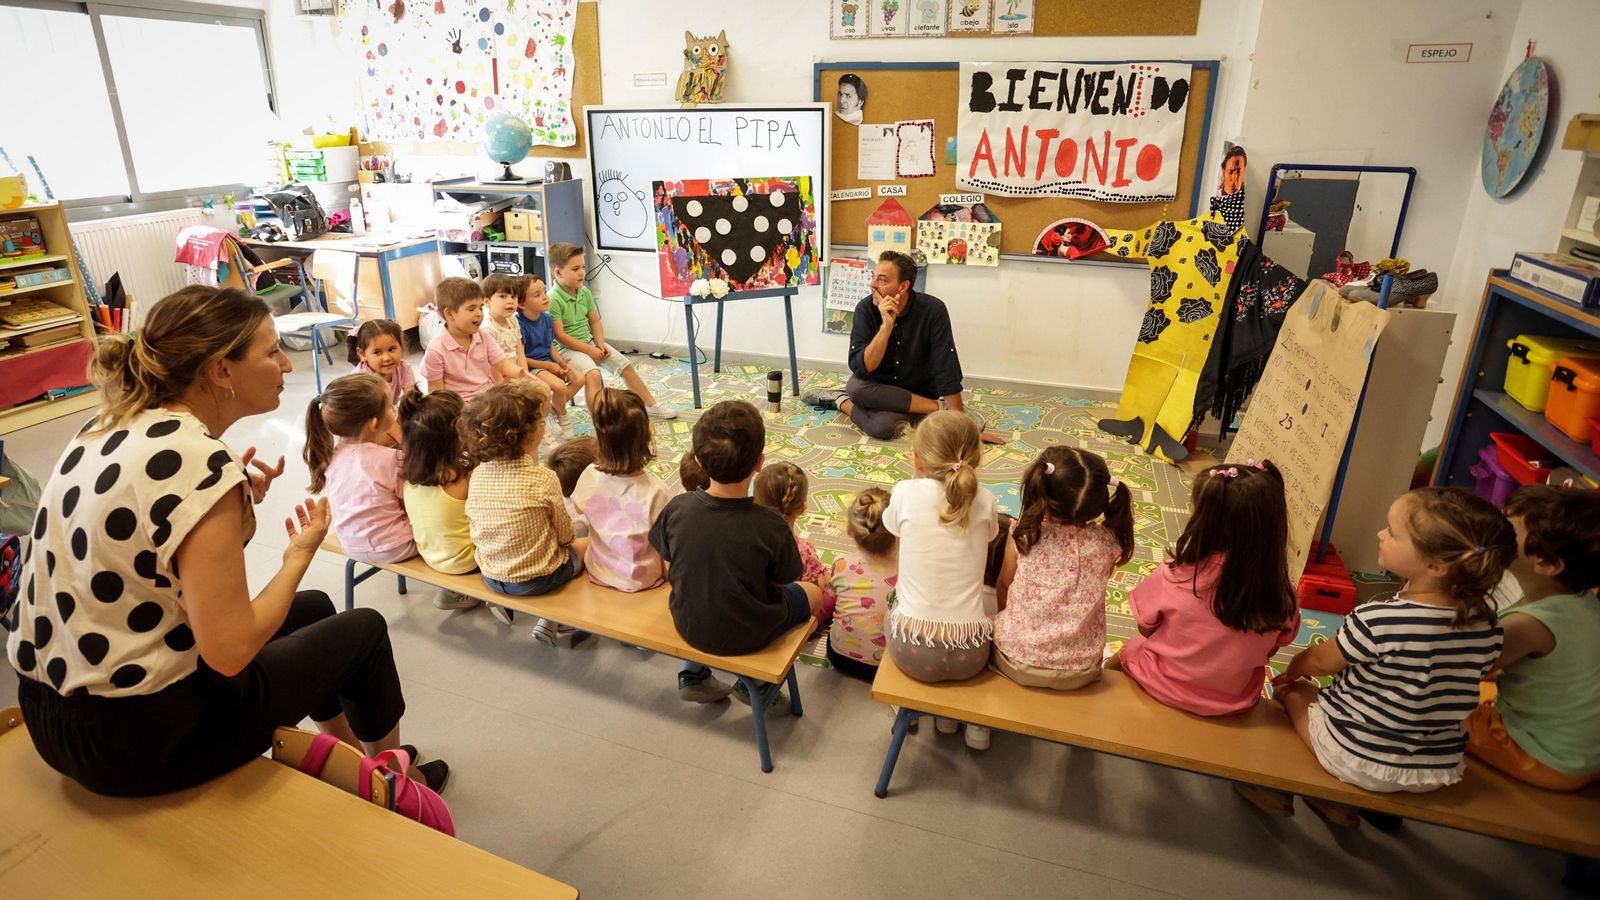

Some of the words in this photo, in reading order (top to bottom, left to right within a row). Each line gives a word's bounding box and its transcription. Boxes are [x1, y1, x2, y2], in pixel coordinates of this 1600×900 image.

[1421, 49, 1457, 58] ESPEJO
[969, 65, 1190, 118] BIENVENIDO
[601, 115, 691, 141] ANTONIO
[699, 117, 722, 145] EL
[736, 117, 801, 151] PIPA
[969, 125, 1163, 188] ANTONIO
[943, 195, 982, 203] COLEGIO
[1279, 413, 1293, 430] 25
